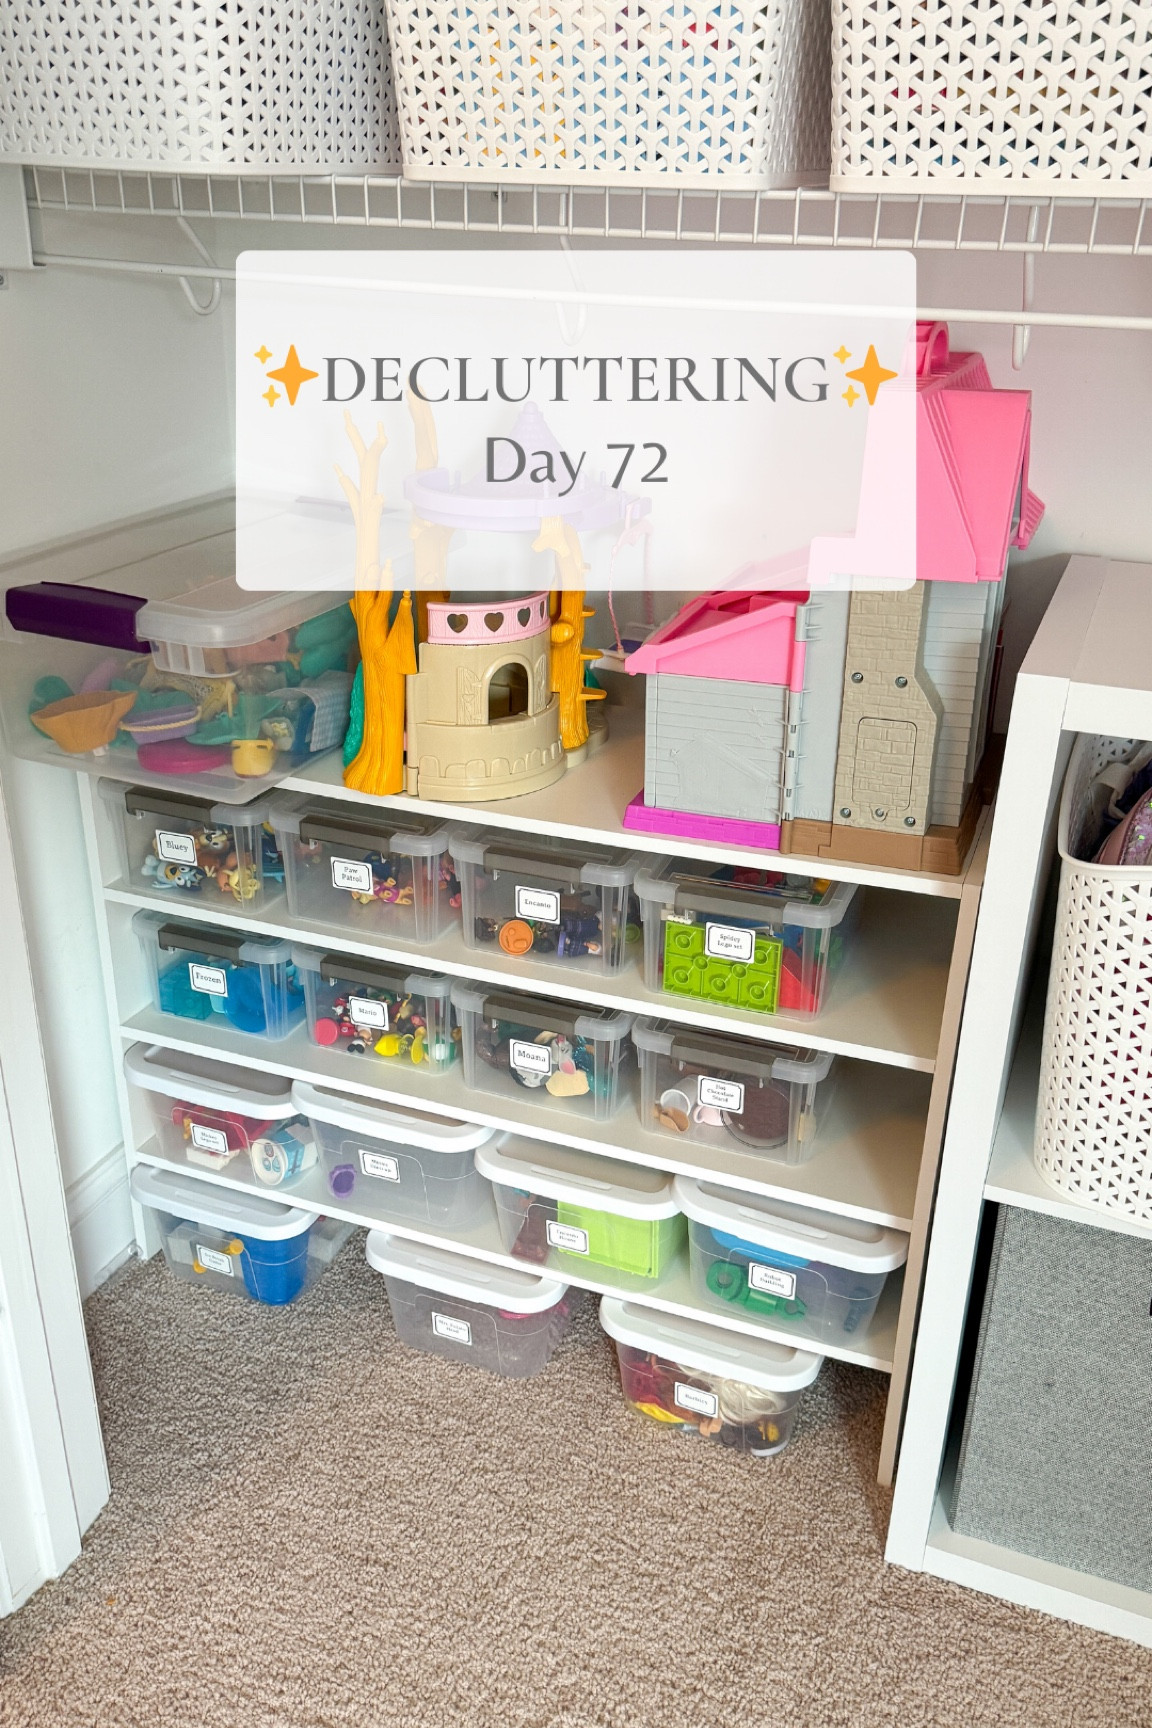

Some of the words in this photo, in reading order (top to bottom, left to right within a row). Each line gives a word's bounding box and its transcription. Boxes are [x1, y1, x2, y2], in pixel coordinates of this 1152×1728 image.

[166, 840, 188, 852] Bluey
[344, 866, 358, 874] Paw
[342, 874, 362, 883] Patrol
[195, 972, 222, 984] Frozen
[517, 1049, 546, 1062] Moana
